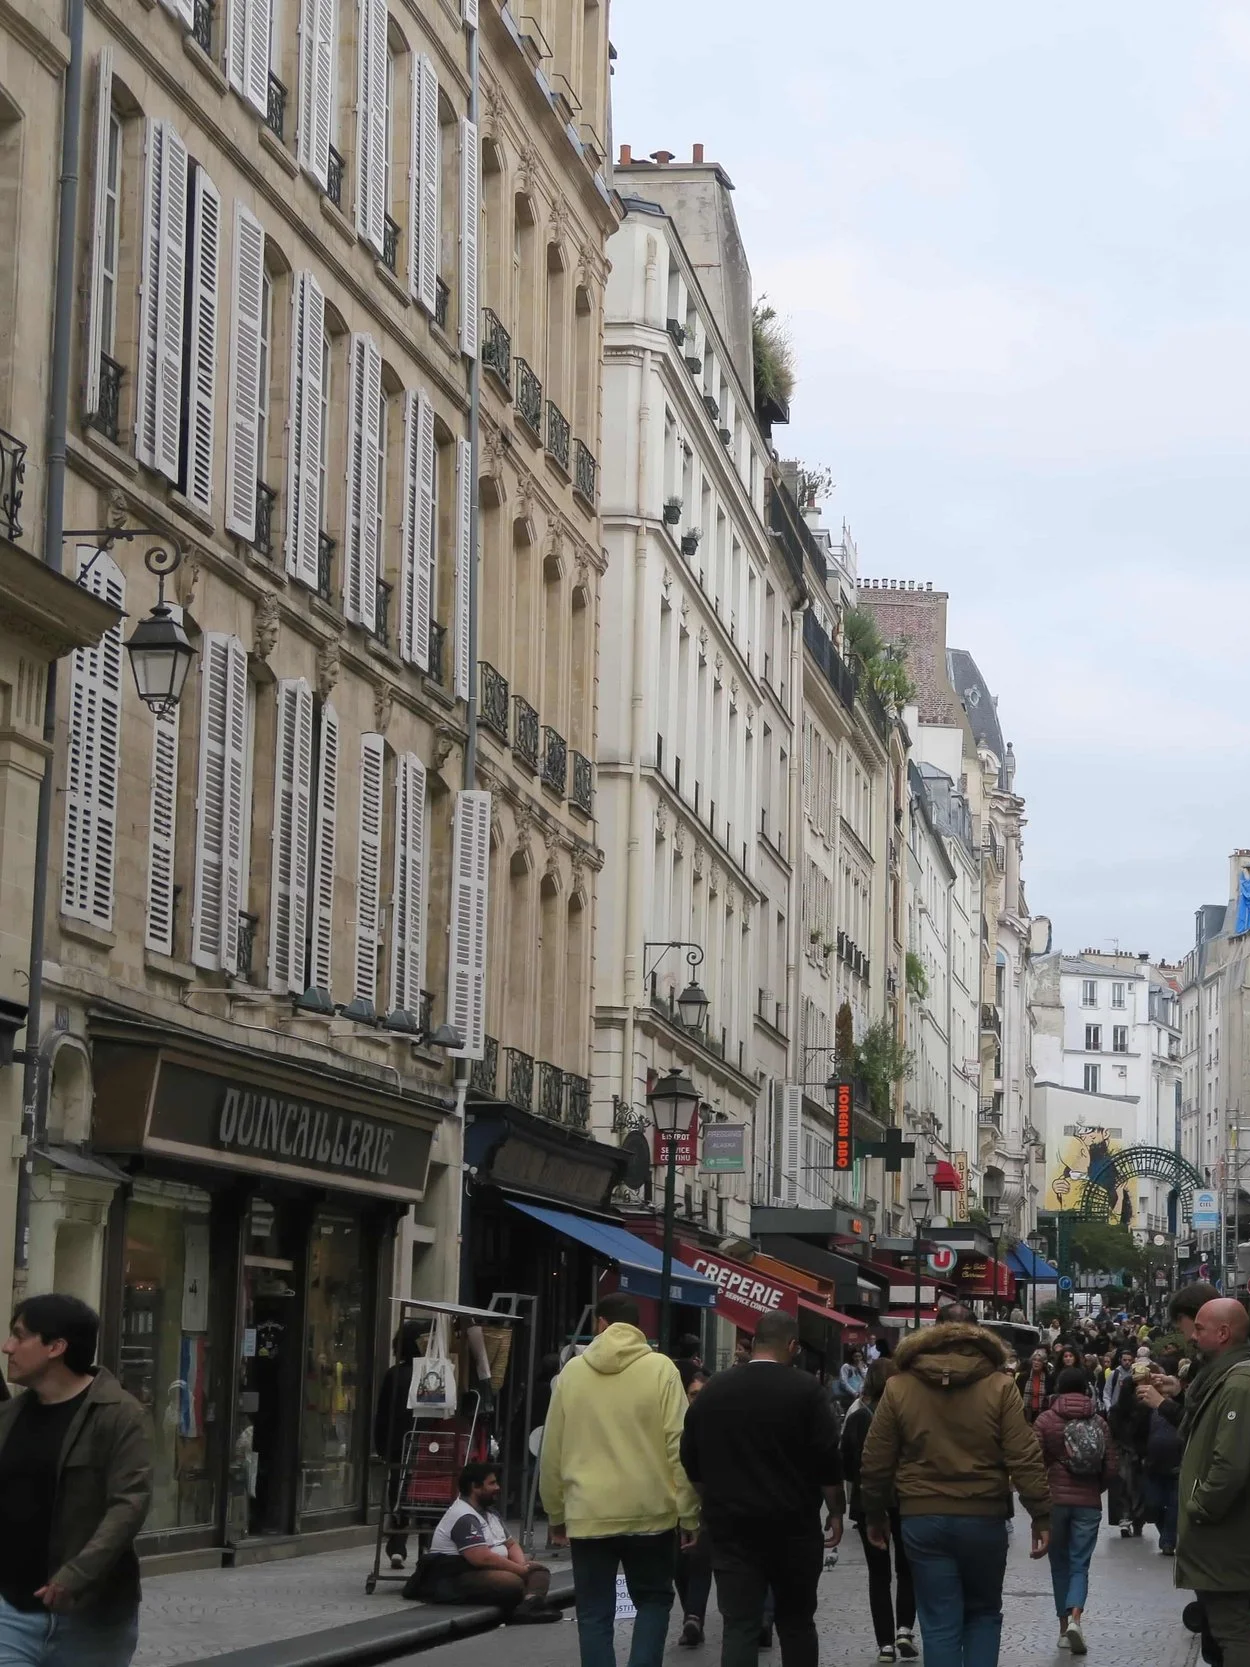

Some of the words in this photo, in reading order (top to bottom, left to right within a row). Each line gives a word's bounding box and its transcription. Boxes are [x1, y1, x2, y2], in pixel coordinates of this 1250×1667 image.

[838, 1085, 850, 1137] KOREAN
[219, 1087, 396, 1176] QUINCAILLERIE
[836, 1141, 849, 1168] BBQ
[725, 1291, 751, 1306] SERVICE
